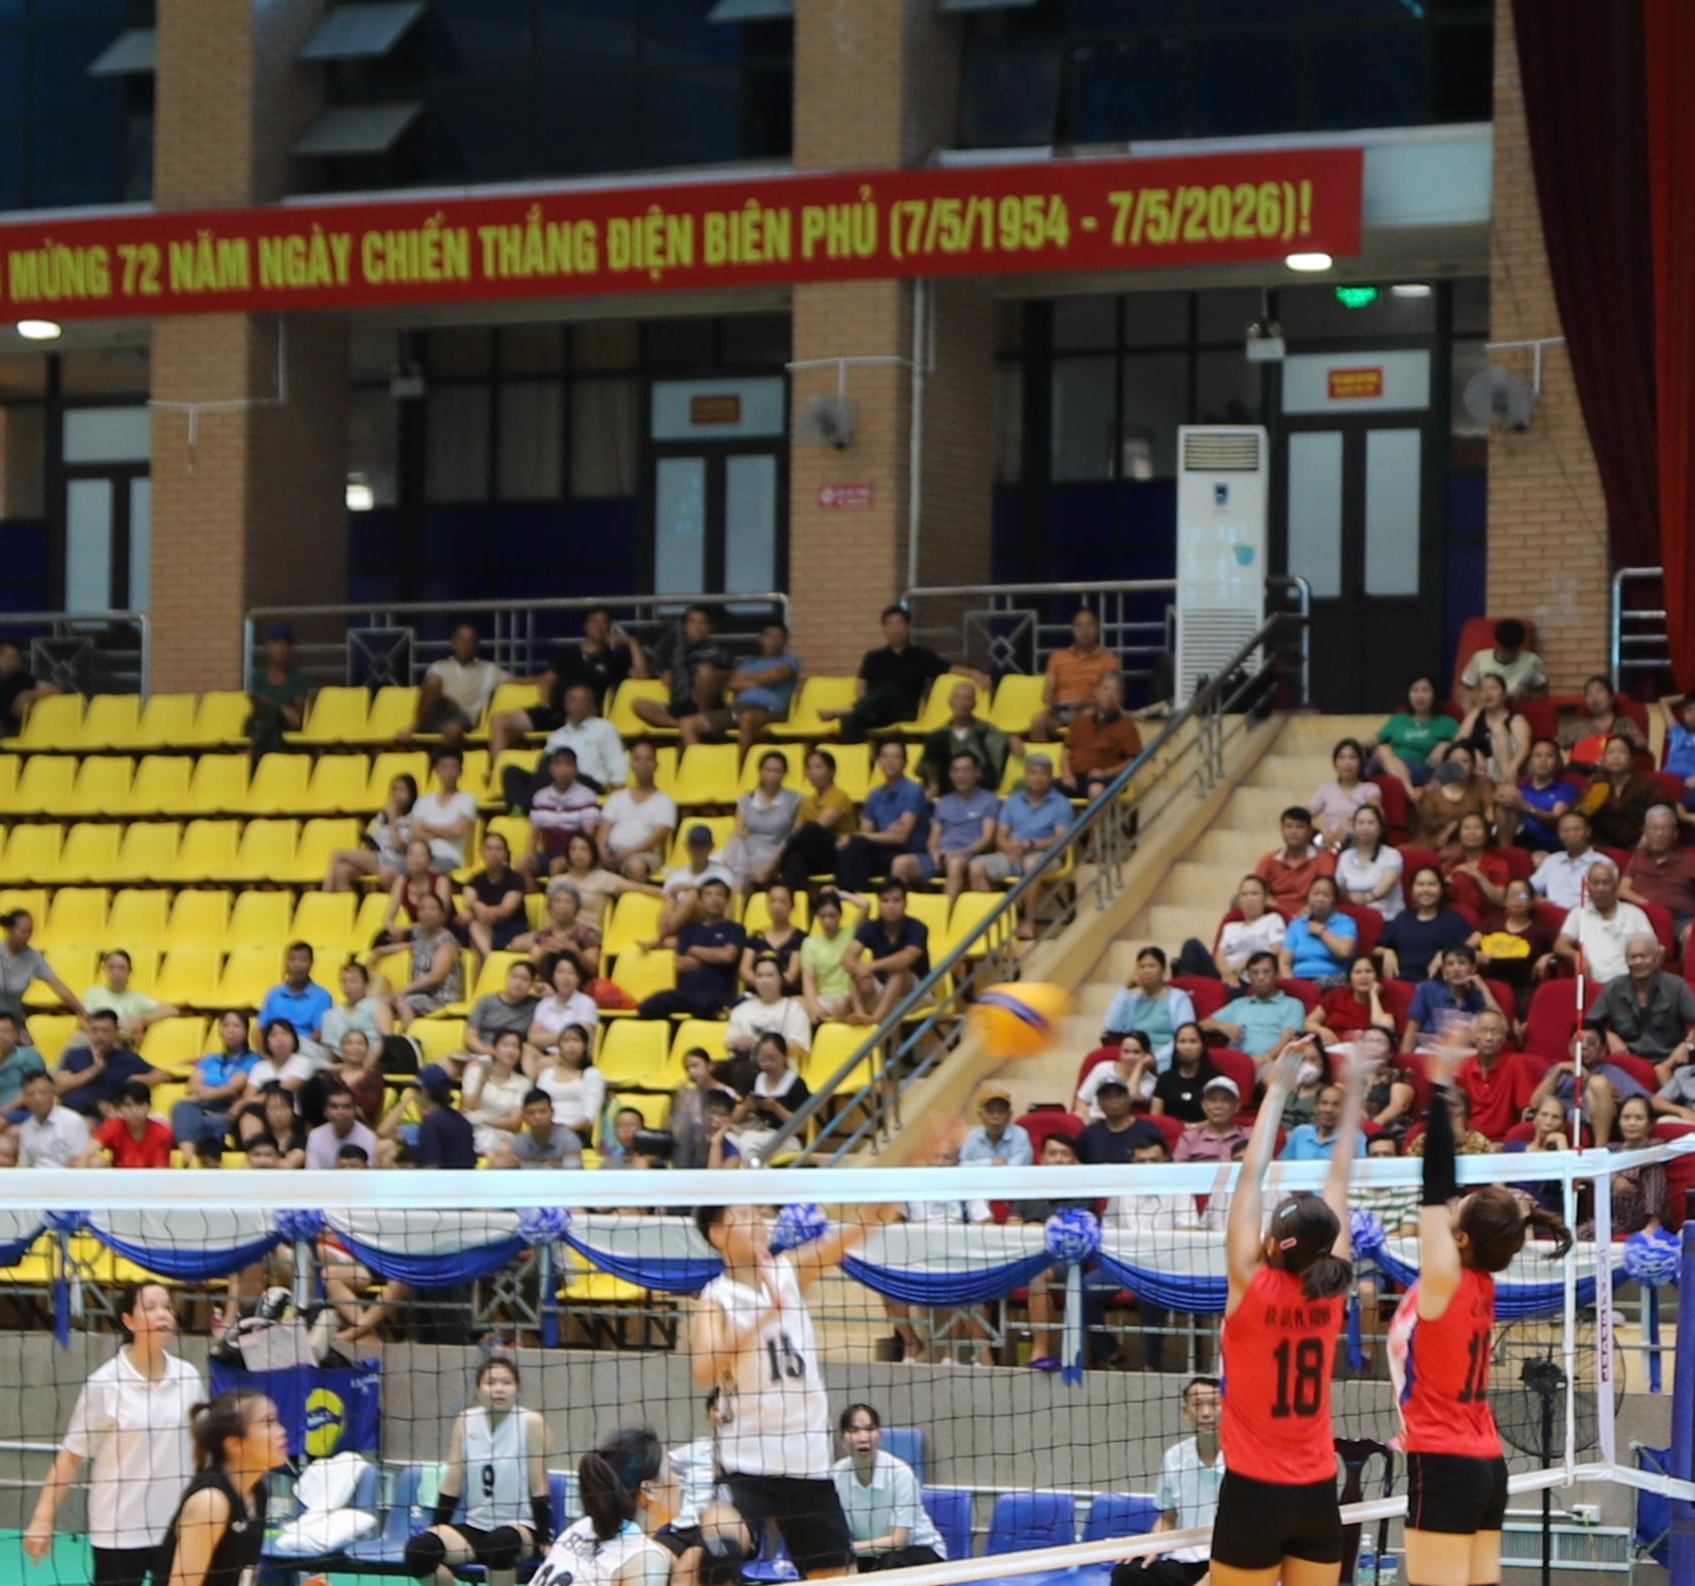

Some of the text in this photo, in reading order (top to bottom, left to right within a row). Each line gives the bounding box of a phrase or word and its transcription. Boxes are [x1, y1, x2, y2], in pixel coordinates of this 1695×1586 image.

[8, 237, 108, 302] MỪNG
[120, 243, 160, 295] 72
[168, 229, 250, 293] NĂM
[258, 223, 352, 289] NGÀY
[361, 211, 468, 284] CHIẾN
[479, 203, 598, 276] THẮNG
[607, 203, 693, 282] ĐIỆN
[704, 200, 792, 267] BIÊN
[801, 184, 877, 259] PHỦ
[889, 194, 1070, 258] (7/5/1954
[1109, 181, 1312, 246] 7/5/2026)!
[1271, 1336, 1324, 1418] 18
[482, 1464, 495, 1497] 9
